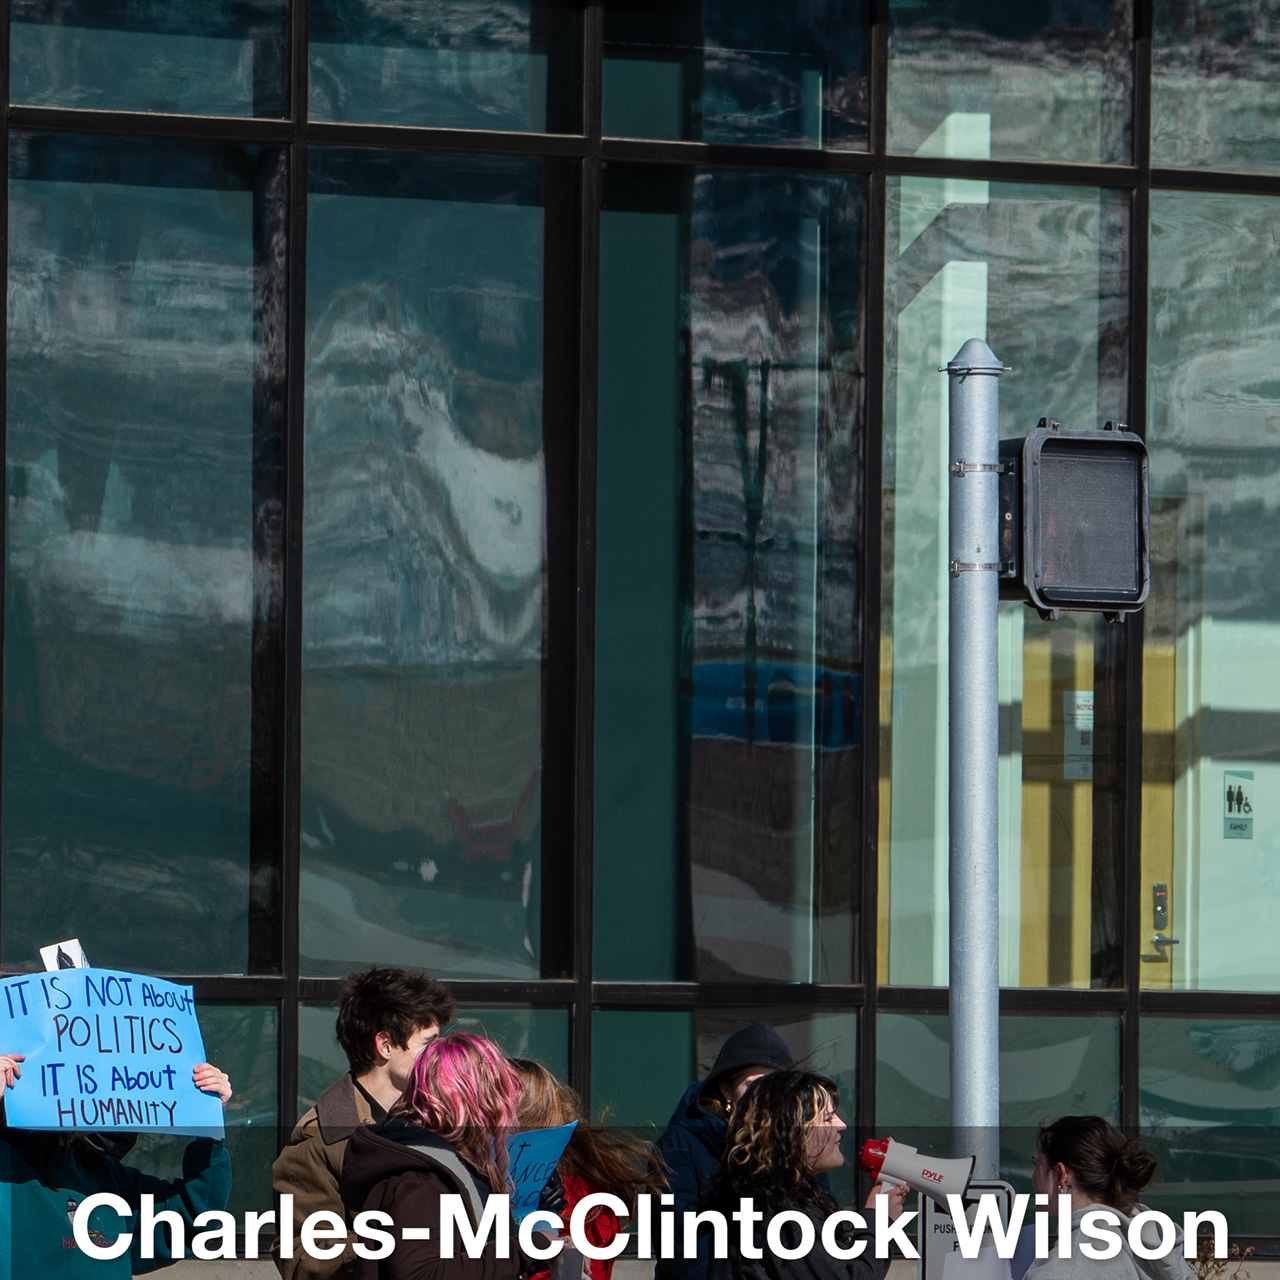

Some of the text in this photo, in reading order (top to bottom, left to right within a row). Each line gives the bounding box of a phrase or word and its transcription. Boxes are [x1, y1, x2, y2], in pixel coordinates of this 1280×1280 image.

[4, 980, 30, 1019] IT
[41, 976, 72, 1010] IS
[85, 975, 133, 1007] NOT
[53, 1013, 183, 1054] POLITICS
[41, 1063, 177, 1097] IT IS About
[934, 1223, 956, 1234] PUSH
